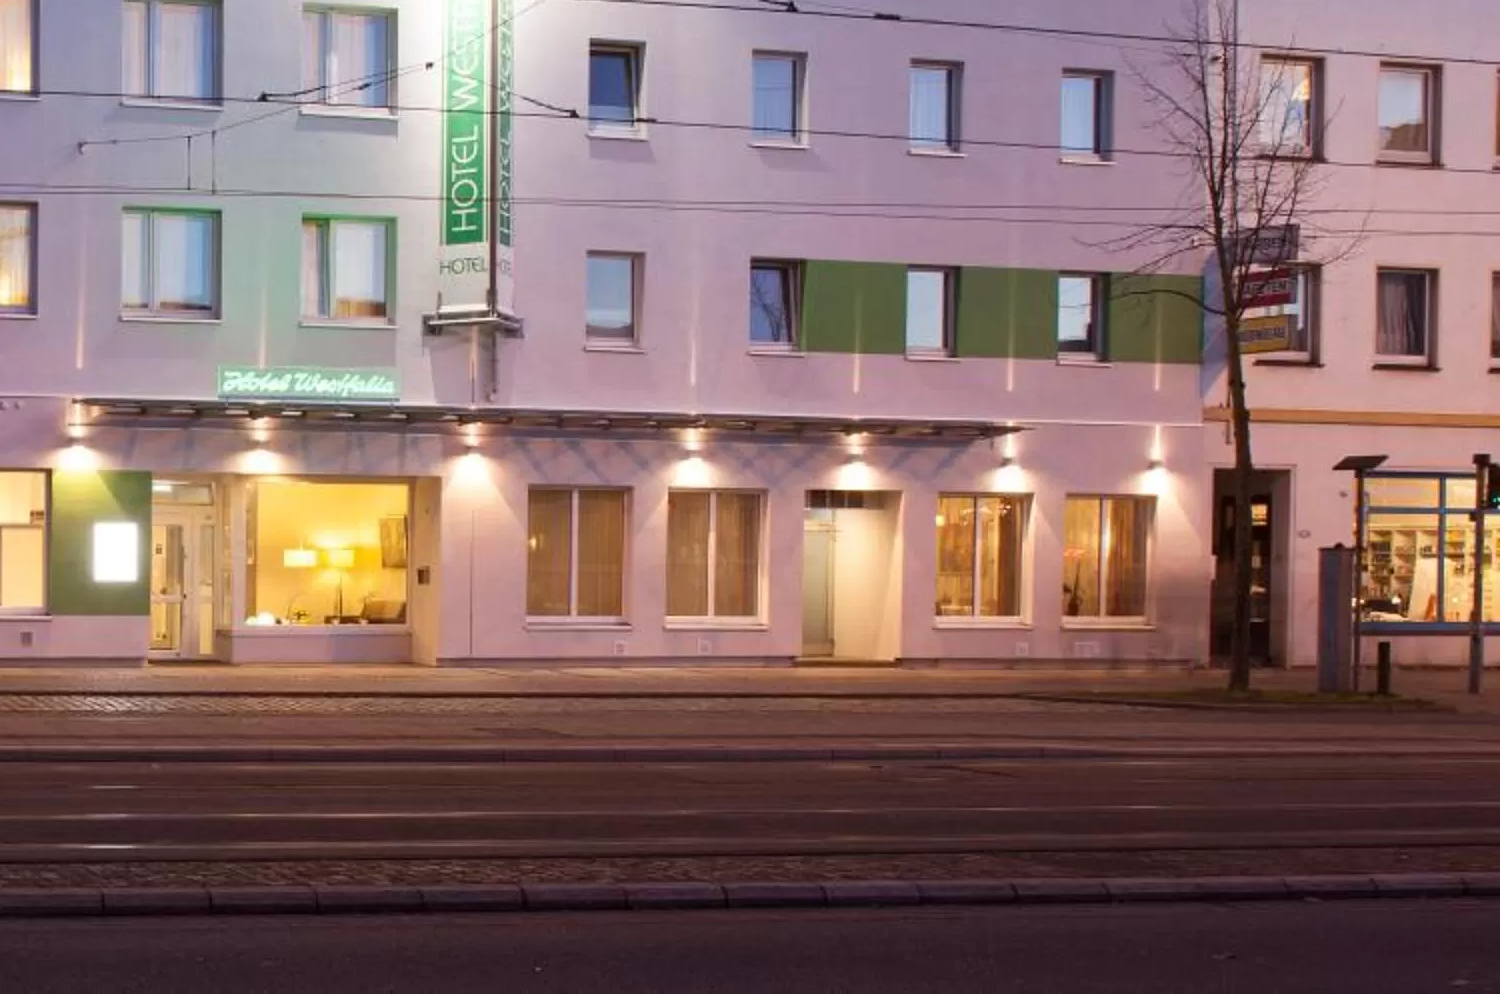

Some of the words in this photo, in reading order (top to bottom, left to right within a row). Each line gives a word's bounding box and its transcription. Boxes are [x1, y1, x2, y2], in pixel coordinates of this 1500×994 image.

[451, 125, 478, 232] HOTEL
[439, 256, 488, 275] HOTEL
[223, 371, 293, 392] Hotel
